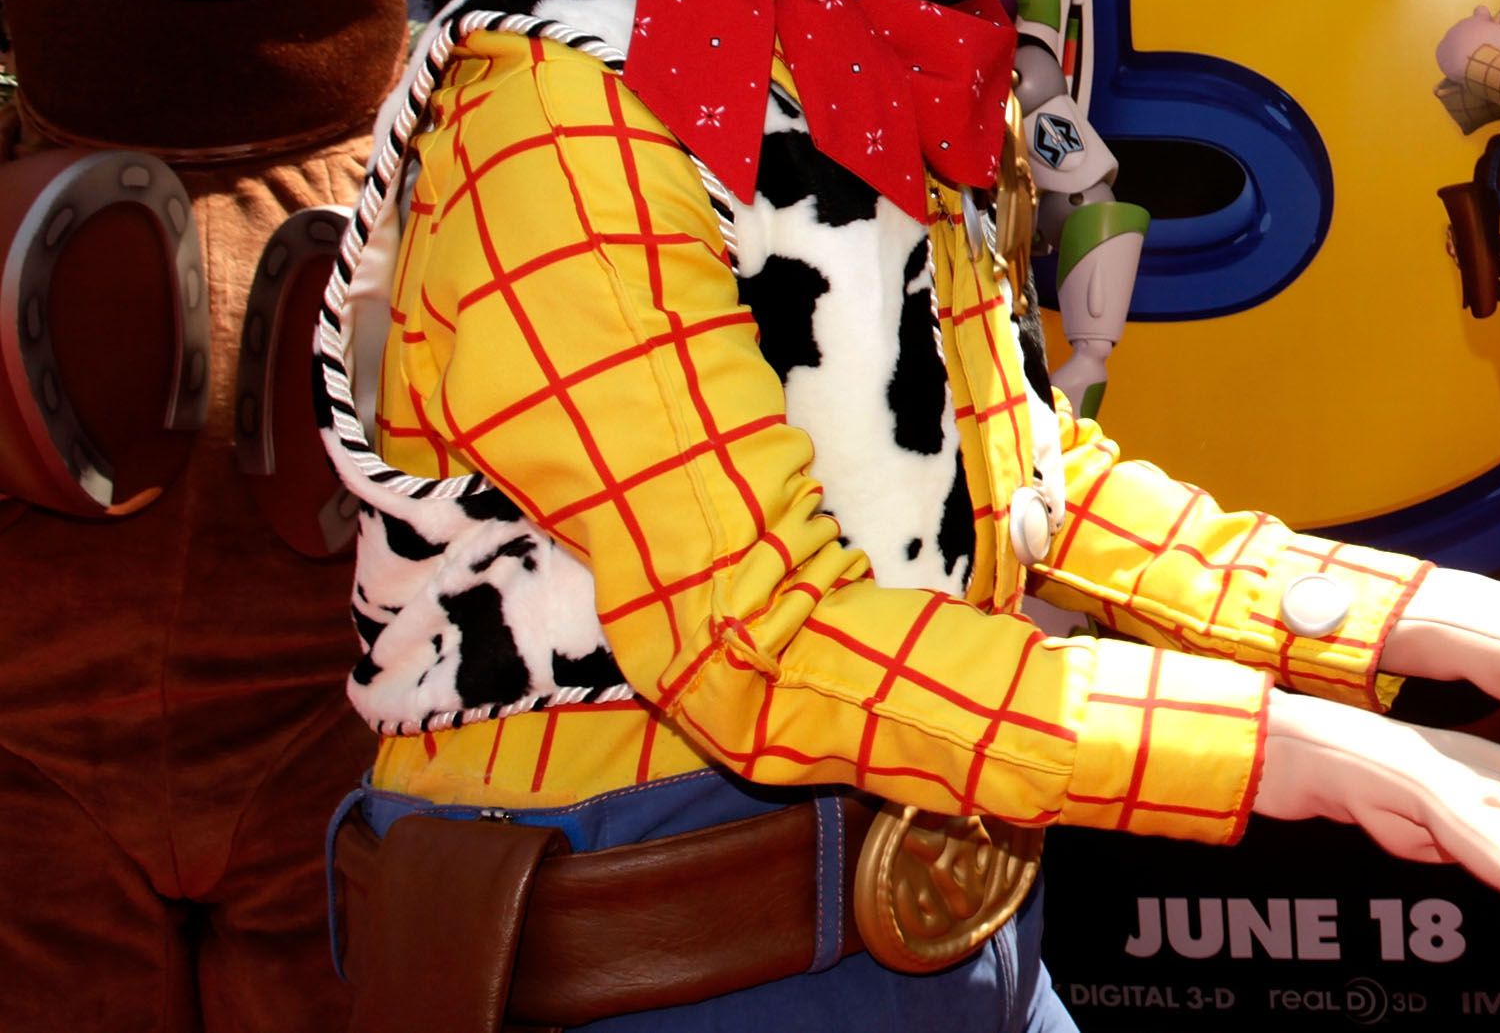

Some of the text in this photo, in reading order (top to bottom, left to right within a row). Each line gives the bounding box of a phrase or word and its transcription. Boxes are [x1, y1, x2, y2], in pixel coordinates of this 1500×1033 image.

[1124, 897, 1467, 964] JUNE 18
[1070, 983, 1236, 1010] DIGITAL 3-D
[1393, 993, 1429, 1015] 3D
